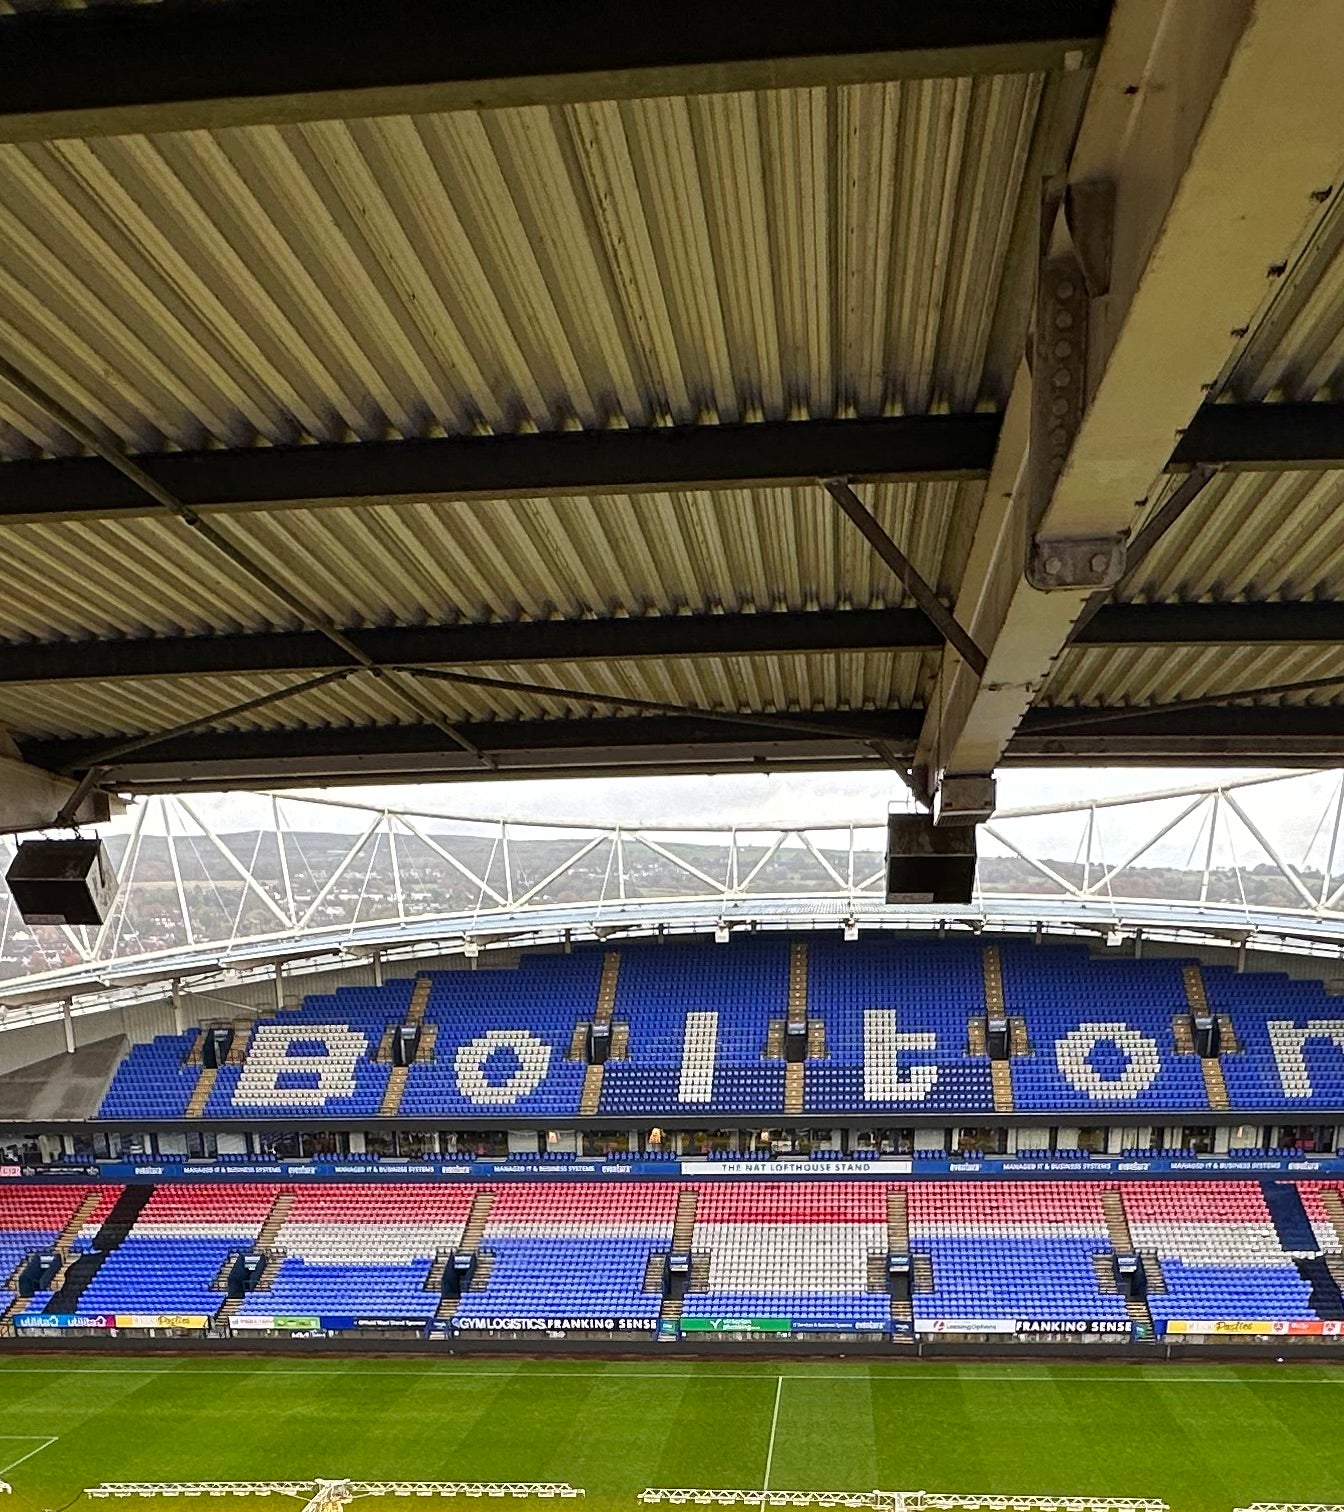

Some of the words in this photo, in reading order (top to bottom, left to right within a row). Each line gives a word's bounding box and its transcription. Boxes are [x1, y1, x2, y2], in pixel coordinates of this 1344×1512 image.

[722, 1163, 741, 1172] THE
[745, 1163, 766, 1172] NAT
[770, 1163, 831, 1172] LOFTHOUSE
[835, 1163, 871, 1172] STAND
[548, 1318, 615, 1329] FRANKING
[619, 1318, 657, 1329] SENSE
[1016, 1320, 1087, 1332] FRANKING
[1091, 1320, 1132, 1332] SENSE
[1216, 1321, 1253, 1332] Pasties
